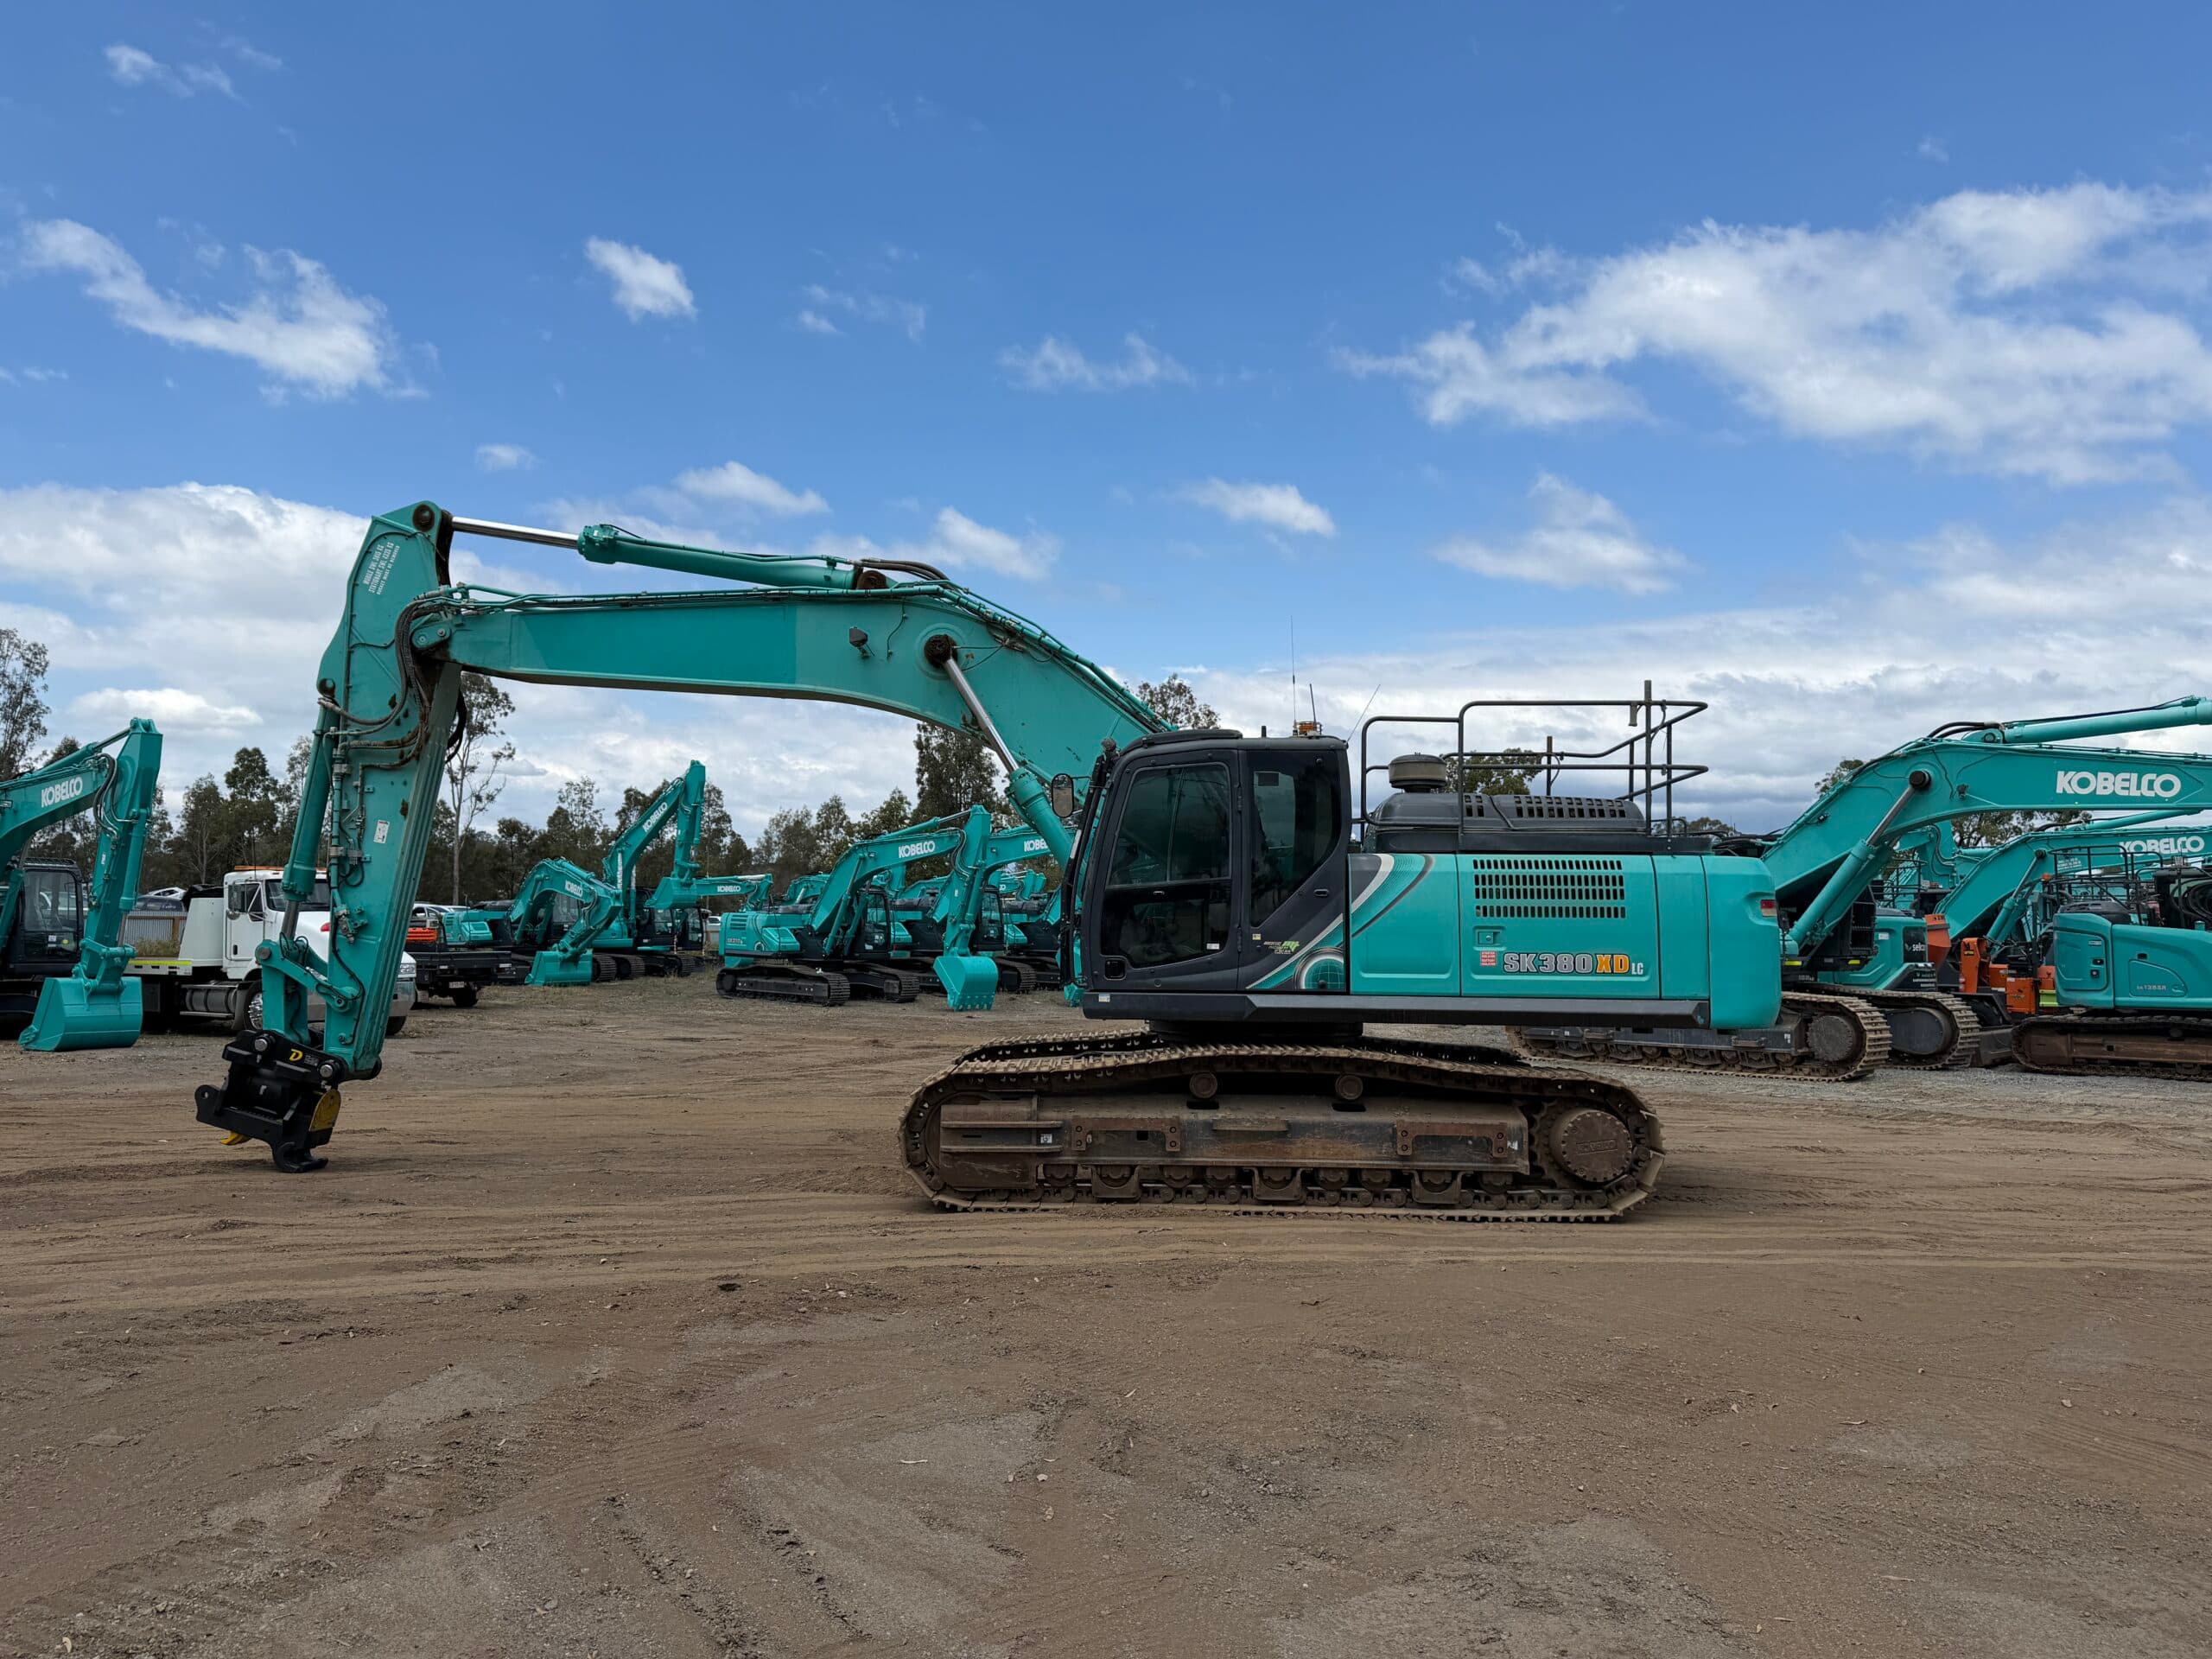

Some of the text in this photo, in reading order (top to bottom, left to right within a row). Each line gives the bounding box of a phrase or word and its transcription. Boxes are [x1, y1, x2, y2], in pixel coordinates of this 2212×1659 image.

[41, 777, 83, 808] KOBELCO
[2056, 771, 2182, 798] KOBELCO
[643, 802, 668, 832] KOBELCO
[898, 840, 936, 858] KOBELCO
[1023, 838, 1049, 853] KOBEL
[2119, 836, 2205, 859] KOBELCO
[564, 880, 583, 898] KOBELCO
[1503, 952, 1643, 975] SK380XD LC
